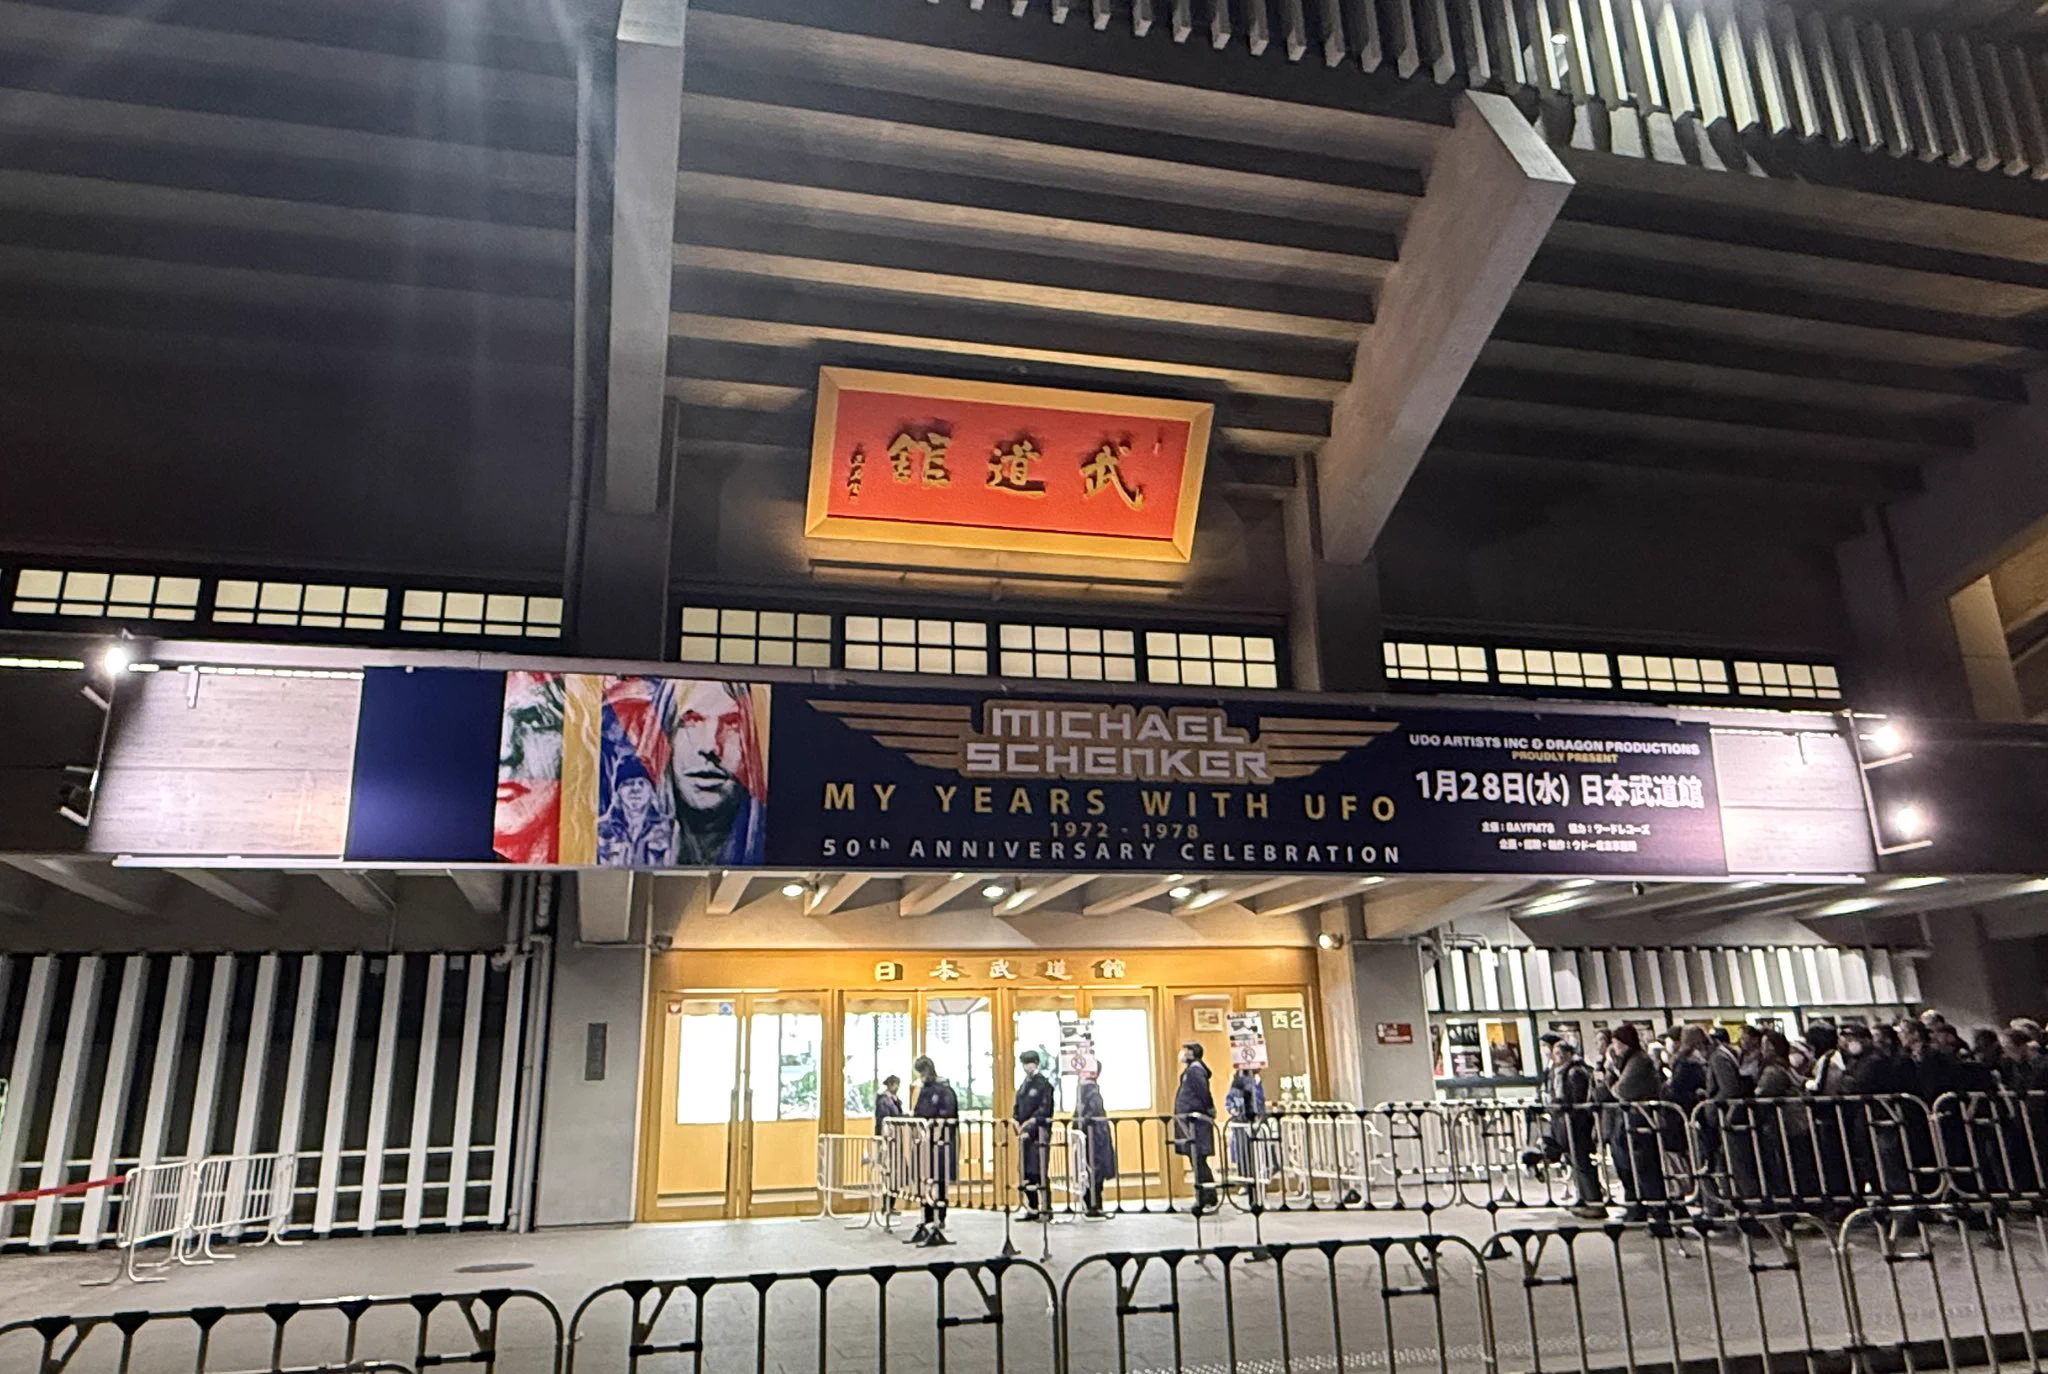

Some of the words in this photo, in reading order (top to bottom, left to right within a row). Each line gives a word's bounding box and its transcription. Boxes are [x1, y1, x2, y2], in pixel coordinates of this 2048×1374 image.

[992, 708, 1244, 745] MICHAEL
[1409, 733, 1441, 746] UDO
[1443, 735, 1501, 748] ARTISTS
[1503, 737, 1529, 750] INC
[1531, 738, 1543, 750] &
[1545, 739, 1603, 752] DRAGON
[1605, 741, 1700, 756] PRODUCTIONS
[1511, 750, 1565, 762] PROUDLY
[1567, 752, 1618, 764] PRESENT
[966, 742, 1269, 779] SCHENKER
[823, 782, 896, 811] MY
[935, 785, 1105, 816] YEARS
[1141, 790, 1270, 819] WITH
[1304, 794, 1396, 822] UFO
[1415, 770, 1569, 807] 1月28日(水)
[1581, 774, 1704, 809] 日本武道館
[1051, 821, 1109, 838] 1972
[1141, 823, 1199, 840] 1978
[823, 838, 890, 857] 50th
[909, 839, 1155, 862] ANNIVERSARY
[1180, 843, 1399, 864] CELEBRATION
[875, 959, 1127, 982] 日本武道館
